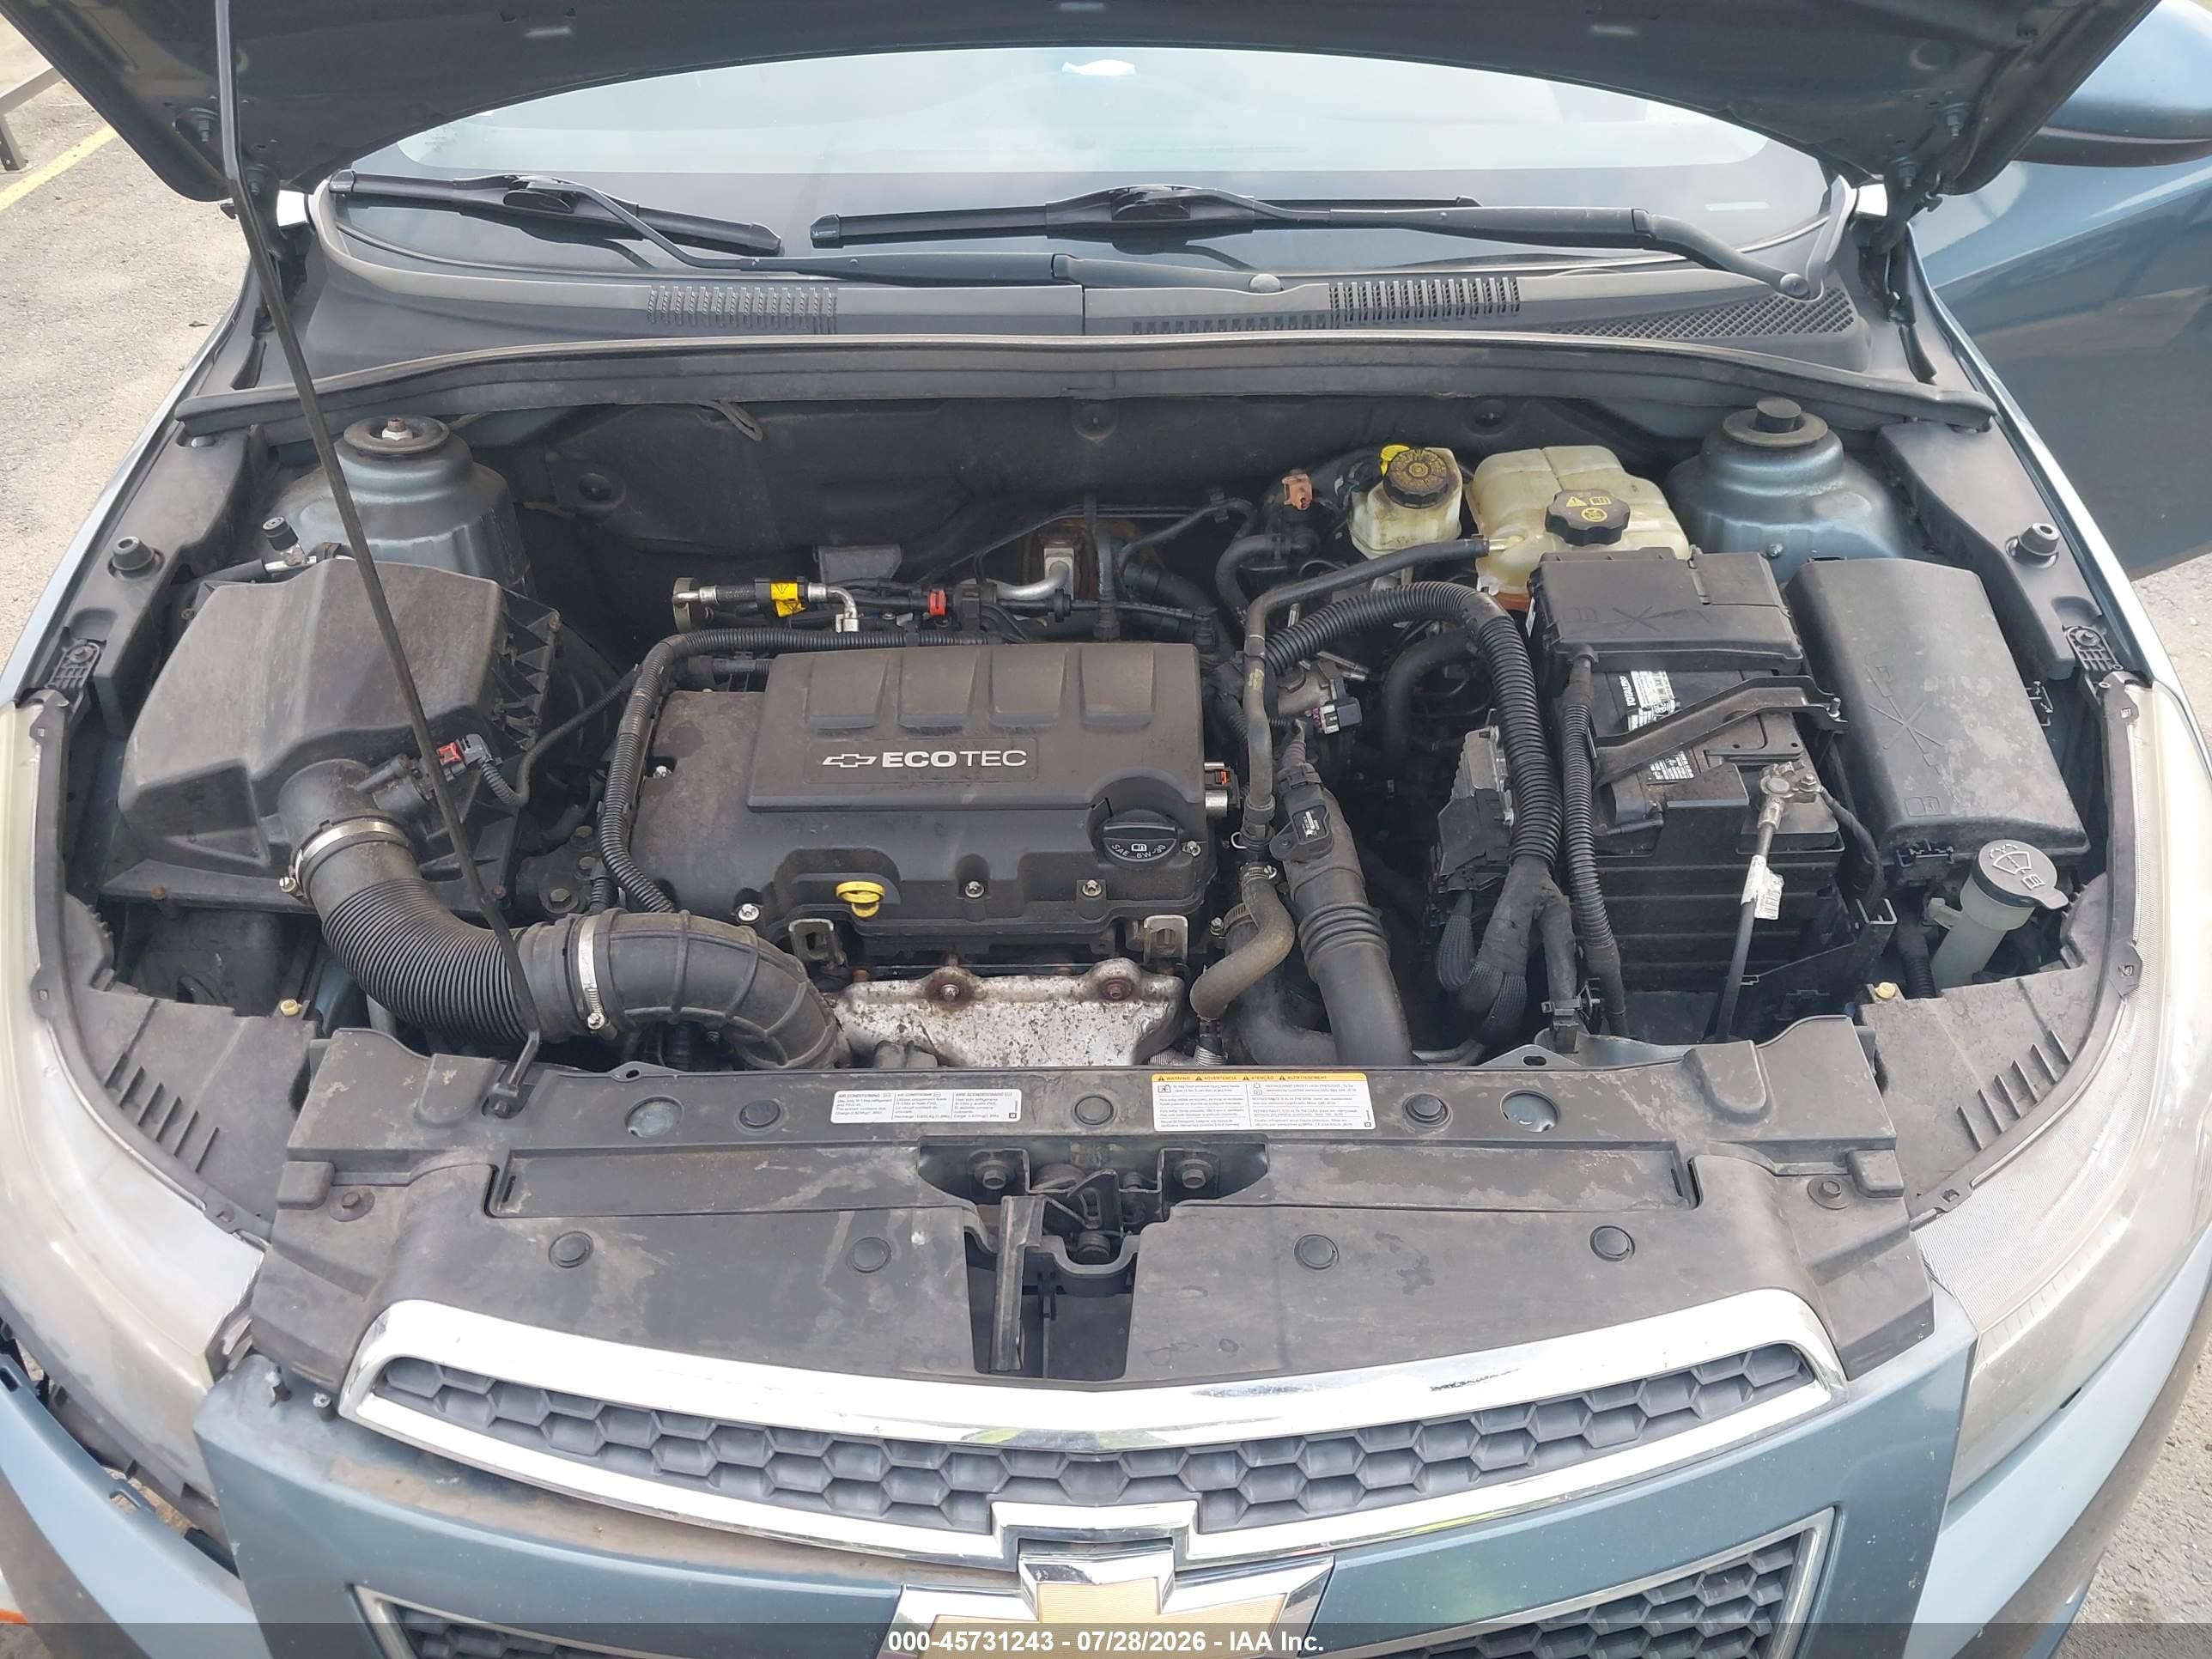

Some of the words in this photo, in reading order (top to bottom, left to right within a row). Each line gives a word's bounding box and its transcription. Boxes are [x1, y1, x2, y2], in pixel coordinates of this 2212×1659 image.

[882, 750, 1027, 768] ECOTEC
[1111, 844, 1131, 857] SAE
[1136, 844, 1167, 859] 5W-30
